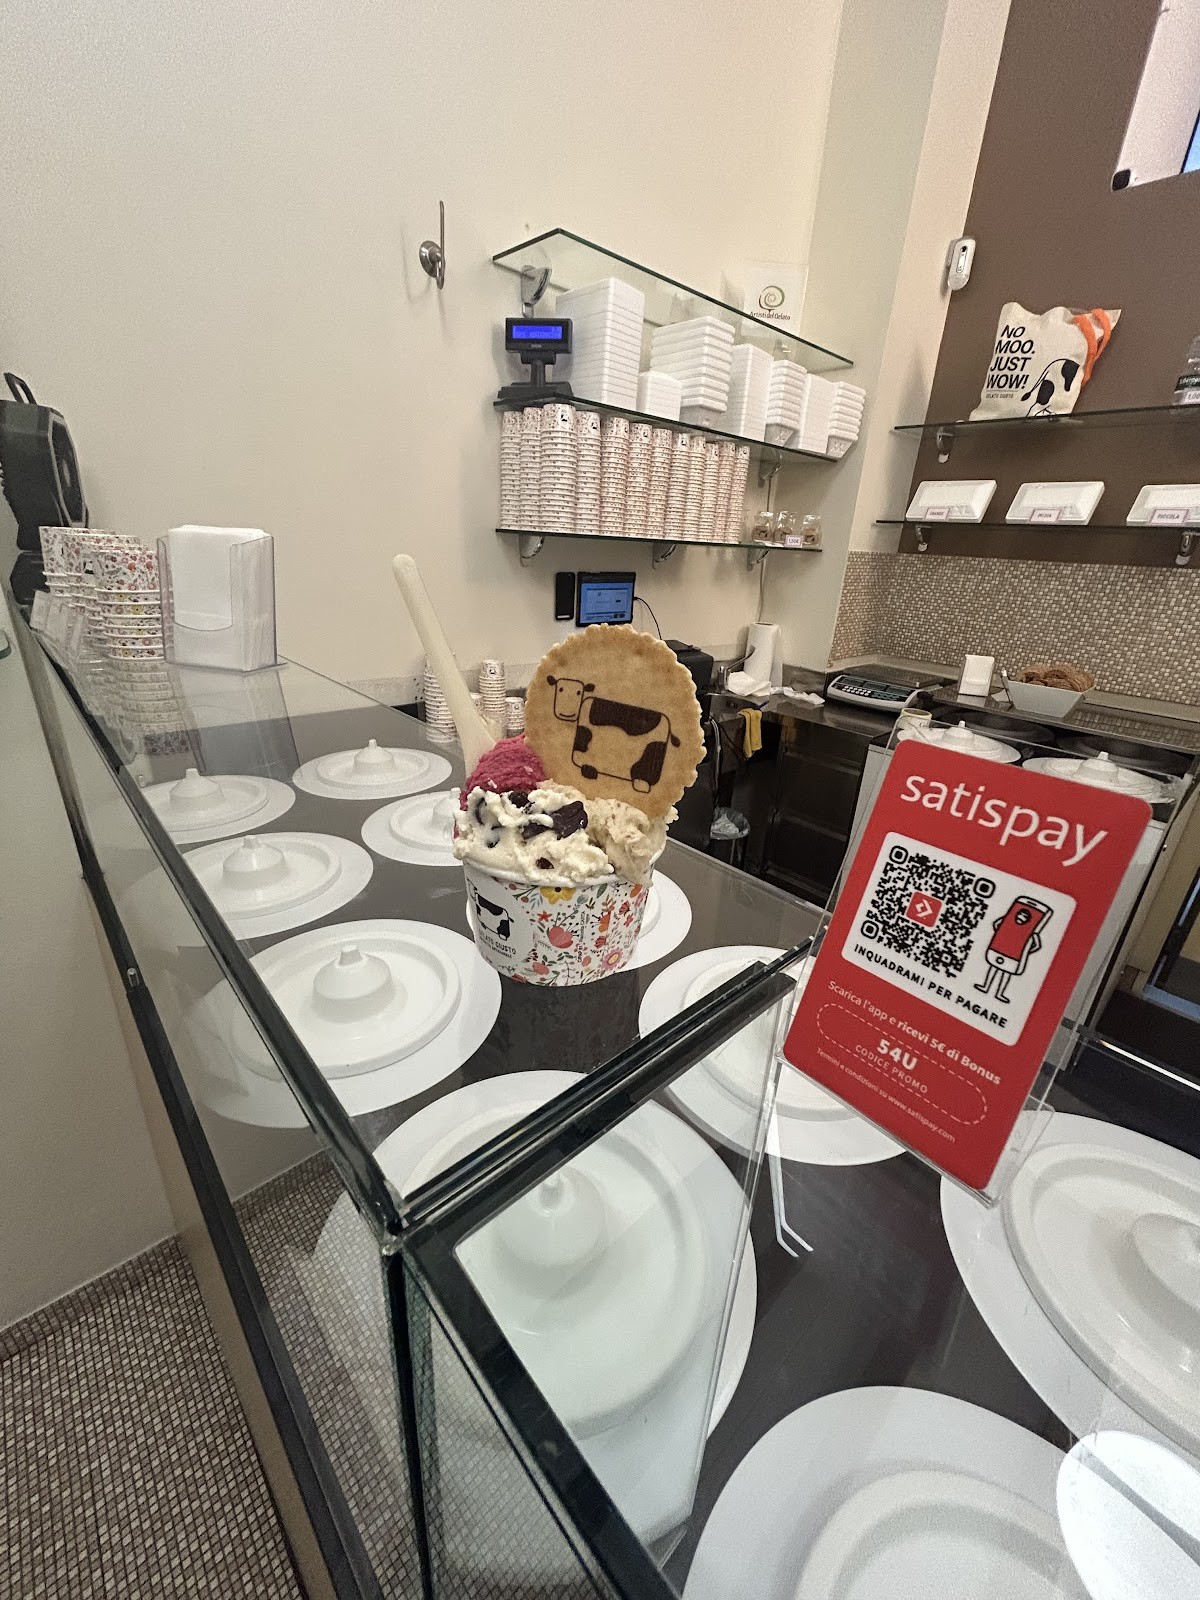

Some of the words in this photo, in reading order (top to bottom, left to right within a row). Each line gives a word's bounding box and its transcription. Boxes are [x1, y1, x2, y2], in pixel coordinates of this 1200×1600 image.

[994, 339, 1036, 355] MOO.
[1000, 324, 1026, 338] NO
[986, 374, 1030, 389] WOW!
[990, 356, 1032, 372] JUST
[900, 774, 1109, 867] satispay
[854, 943, 925, 986] INQUADRAMI
[928, 981, 953, 1000] PER
[955, 995, 1008, 1029] PAGARE
[828, 980, 862, 1006] Scarica
[863, 999, 888, 1021] l'app
[888, 1017, 897, 1026] e
[897, 1020, 929, 1044] ricevi
[930, 1038, 946, 1053] 5€
[946, 1044, 959, 1061] di
[960, 1055, 1002, 1086] Bonus
[855, 1044, 890, 1070] CODICE
[891, 1067, 928, 1094] PROMO
[876, 1038, 919, 1071] 54U
[817, 1047, 840, 1068] Termini
[844, 1067, 879, 1093] condizioni
[879, 1089, 888, 1099] su
[887, 1095, 956, 1143] www.satispay.com
